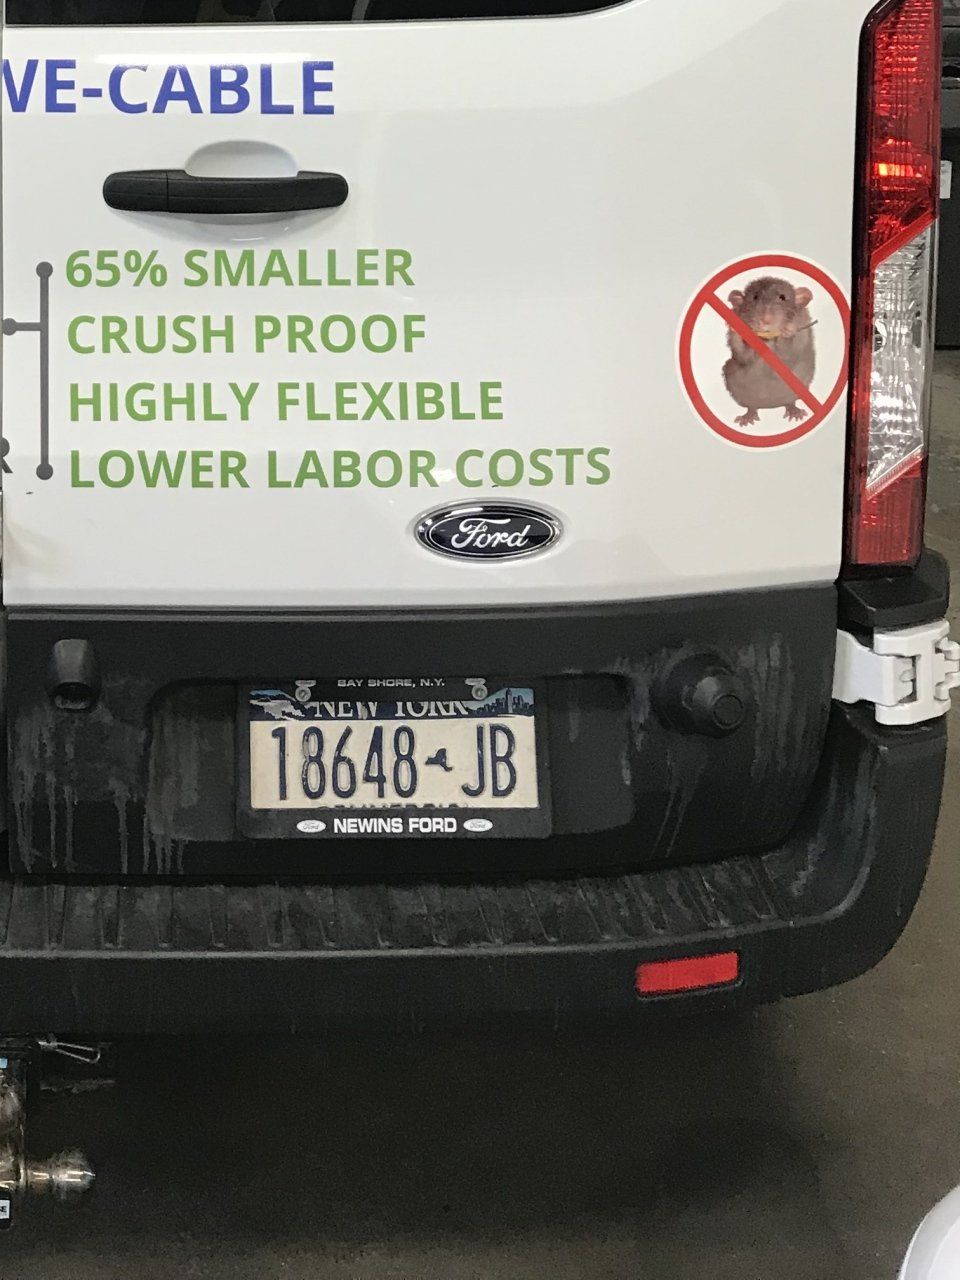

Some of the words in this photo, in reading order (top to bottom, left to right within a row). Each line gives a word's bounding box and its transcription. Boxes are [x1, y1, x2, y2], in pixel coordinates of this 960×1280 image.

[65, 250, 167, 288] 65%
[184, 249, 414, 287] SMALLER
[67, 316, 234, 354] CRUSH
[254, 315, 426, 354] PROOF
[70, 382, 260, 422] HIGHLY
[277, 381, 504, 422] FLEXIBLE
[70, 450, 248, 488] LOWER
[268, 450, 438, 488] LABOR
[456, 447, 611, 487] COSTS
[451, 517, 532, 549] Ford
[337, 678, 363, 687] BAY
[368, 678, 416, 688] SHORE,
[420, 677, 445, 687] N.Y.
[271, 724, 417, 801] 18648
[461, 722, 517, 798] JB
[333, 817, 404, 834] NEWINS
[408, 816, 458, 833] FORD
